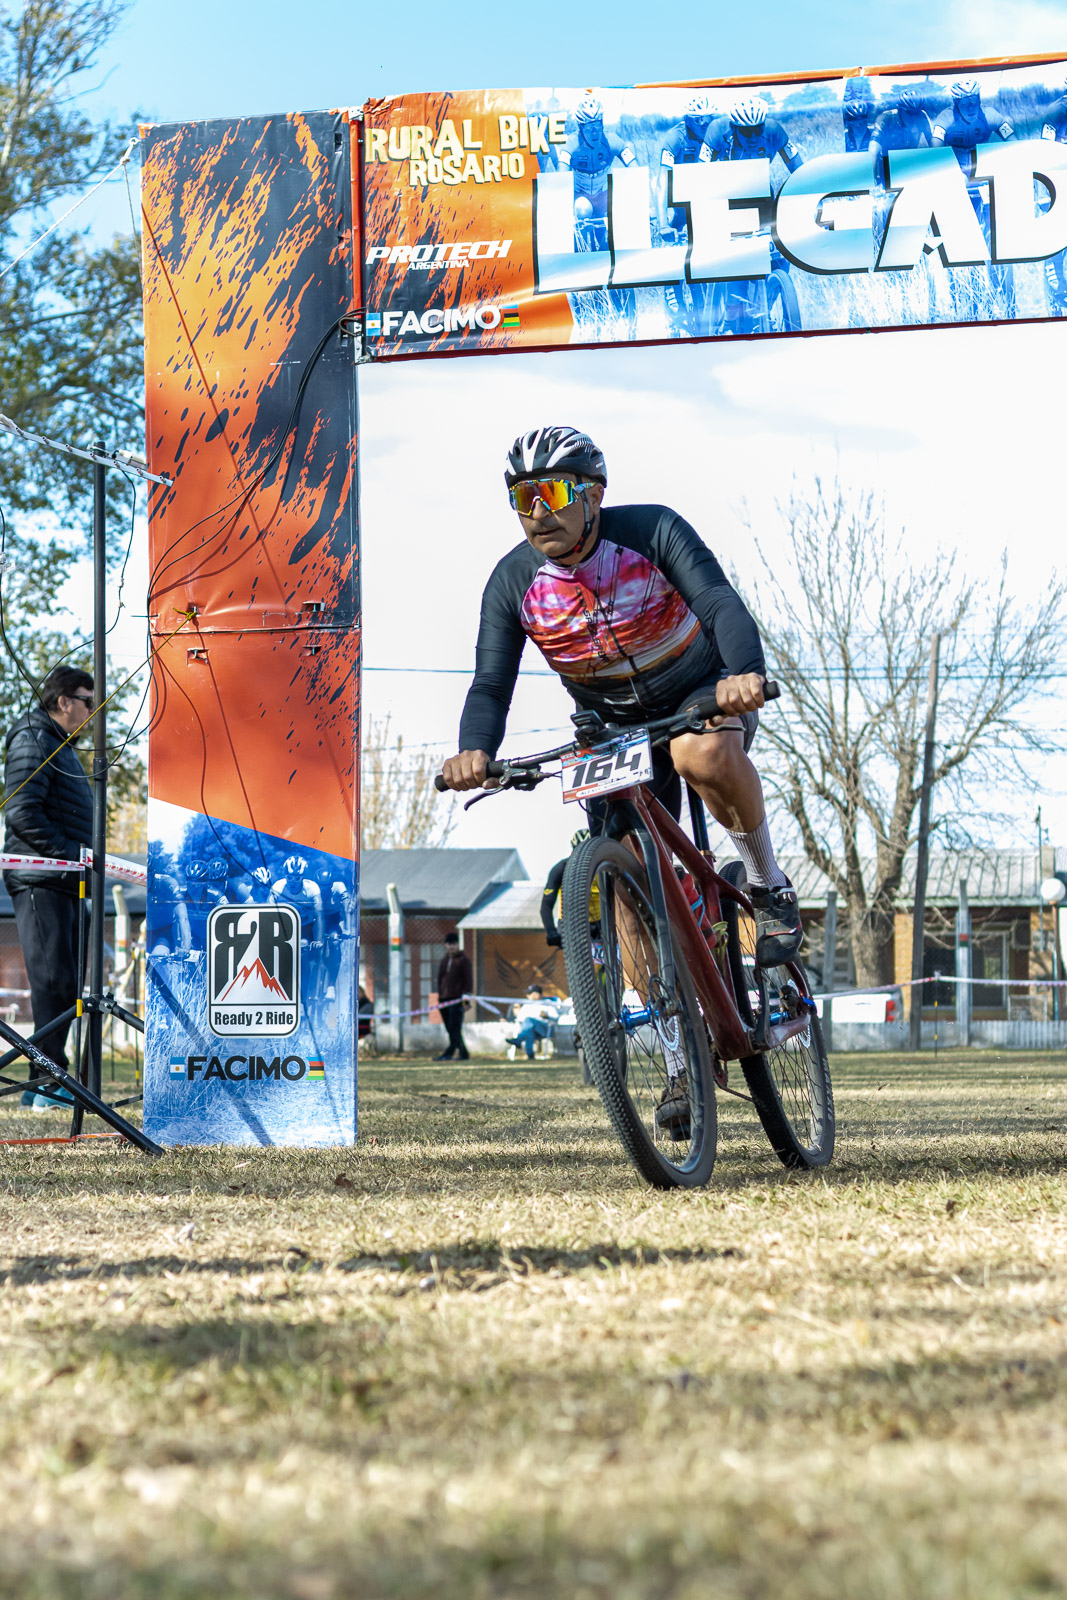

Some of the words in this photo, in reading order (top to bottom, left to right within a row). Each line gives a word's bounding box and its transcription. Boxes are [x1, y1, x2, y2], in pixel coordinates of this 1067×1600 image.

[366, 119, 483, 164] RURAL
[499, 113, 568, 155] BIKE
[409, 153, 526, 187] ROSARIO
[366, 239, 512, 265] PROTECH
[407, 259, 470, 271] ARGENTINA
[382, 304, 501, 336] FACIMO
[572, 749, 642, 789] 164
[214, 1011, 252, 1026] Ready
[255, 1011, 264, 1025] 2
[265, 1011, 294, 1025] Ride
[187, 1055, 306, 1081] FACIMO
